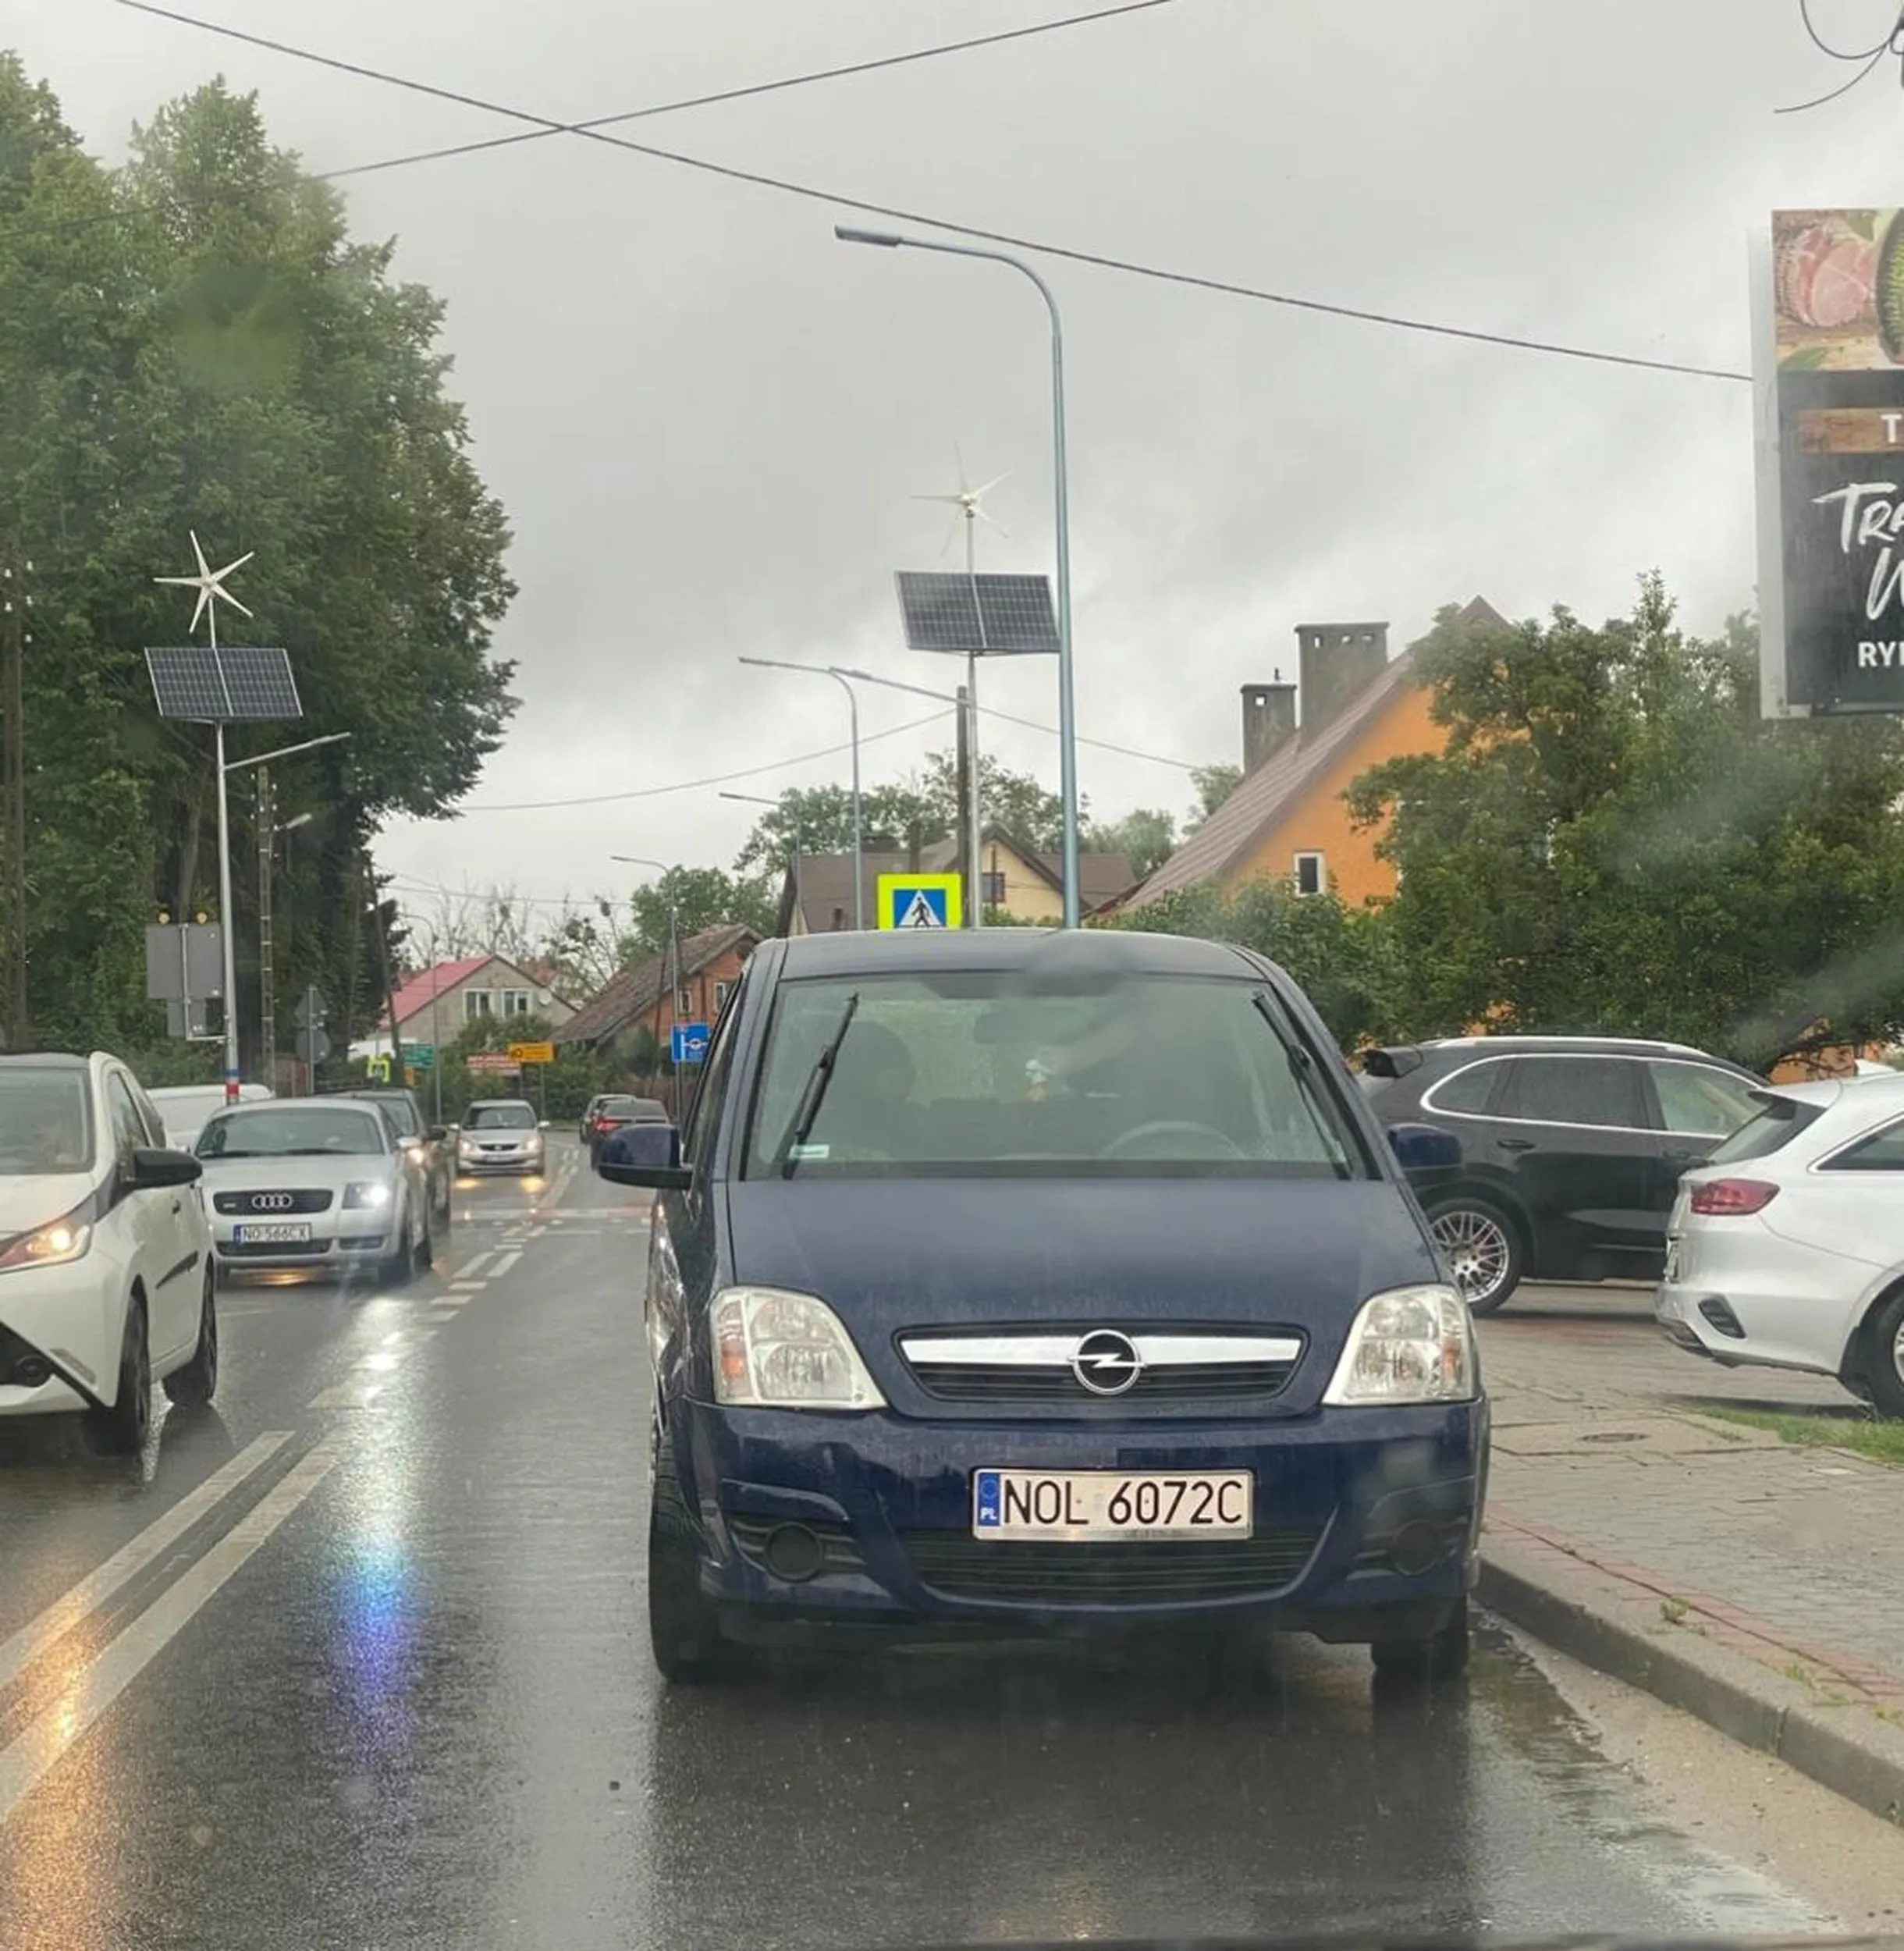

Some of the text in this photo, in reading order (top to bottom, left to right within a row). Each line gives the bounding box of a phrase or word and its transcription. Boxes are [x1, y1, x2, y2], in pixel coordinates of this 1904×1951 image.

[1858, 641, 1904, 667] RY
[980, 1507, 997, 1520] PL
[1004, 1479, 1243, 1526] NOL 6072C
